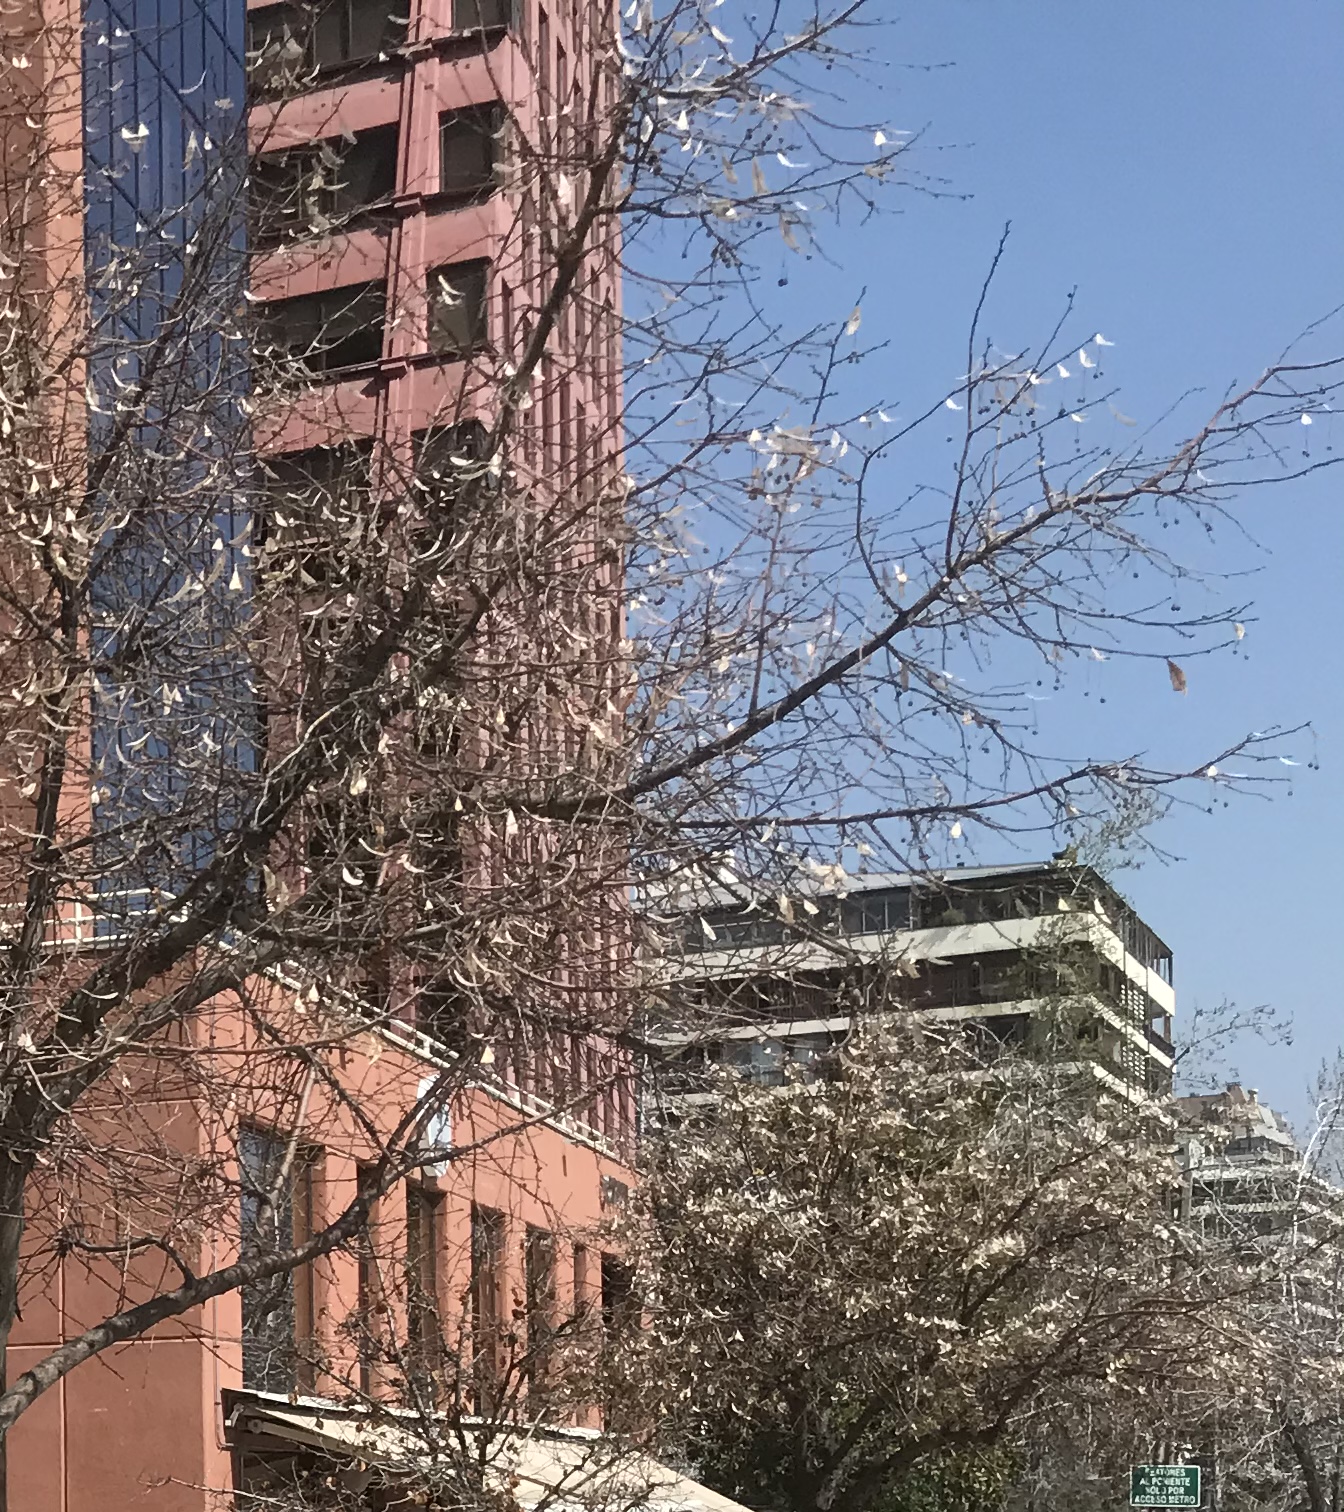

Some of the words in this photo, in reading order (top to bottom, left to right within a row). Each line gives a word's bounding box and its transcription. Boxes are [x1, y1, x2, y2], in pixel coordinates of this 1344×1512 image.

[1168, 1486, 1185, 1495] POR
[1134, 1495, 1167, 1504] ACCESO
[1168, 1495, 1196, 1504] METRO
